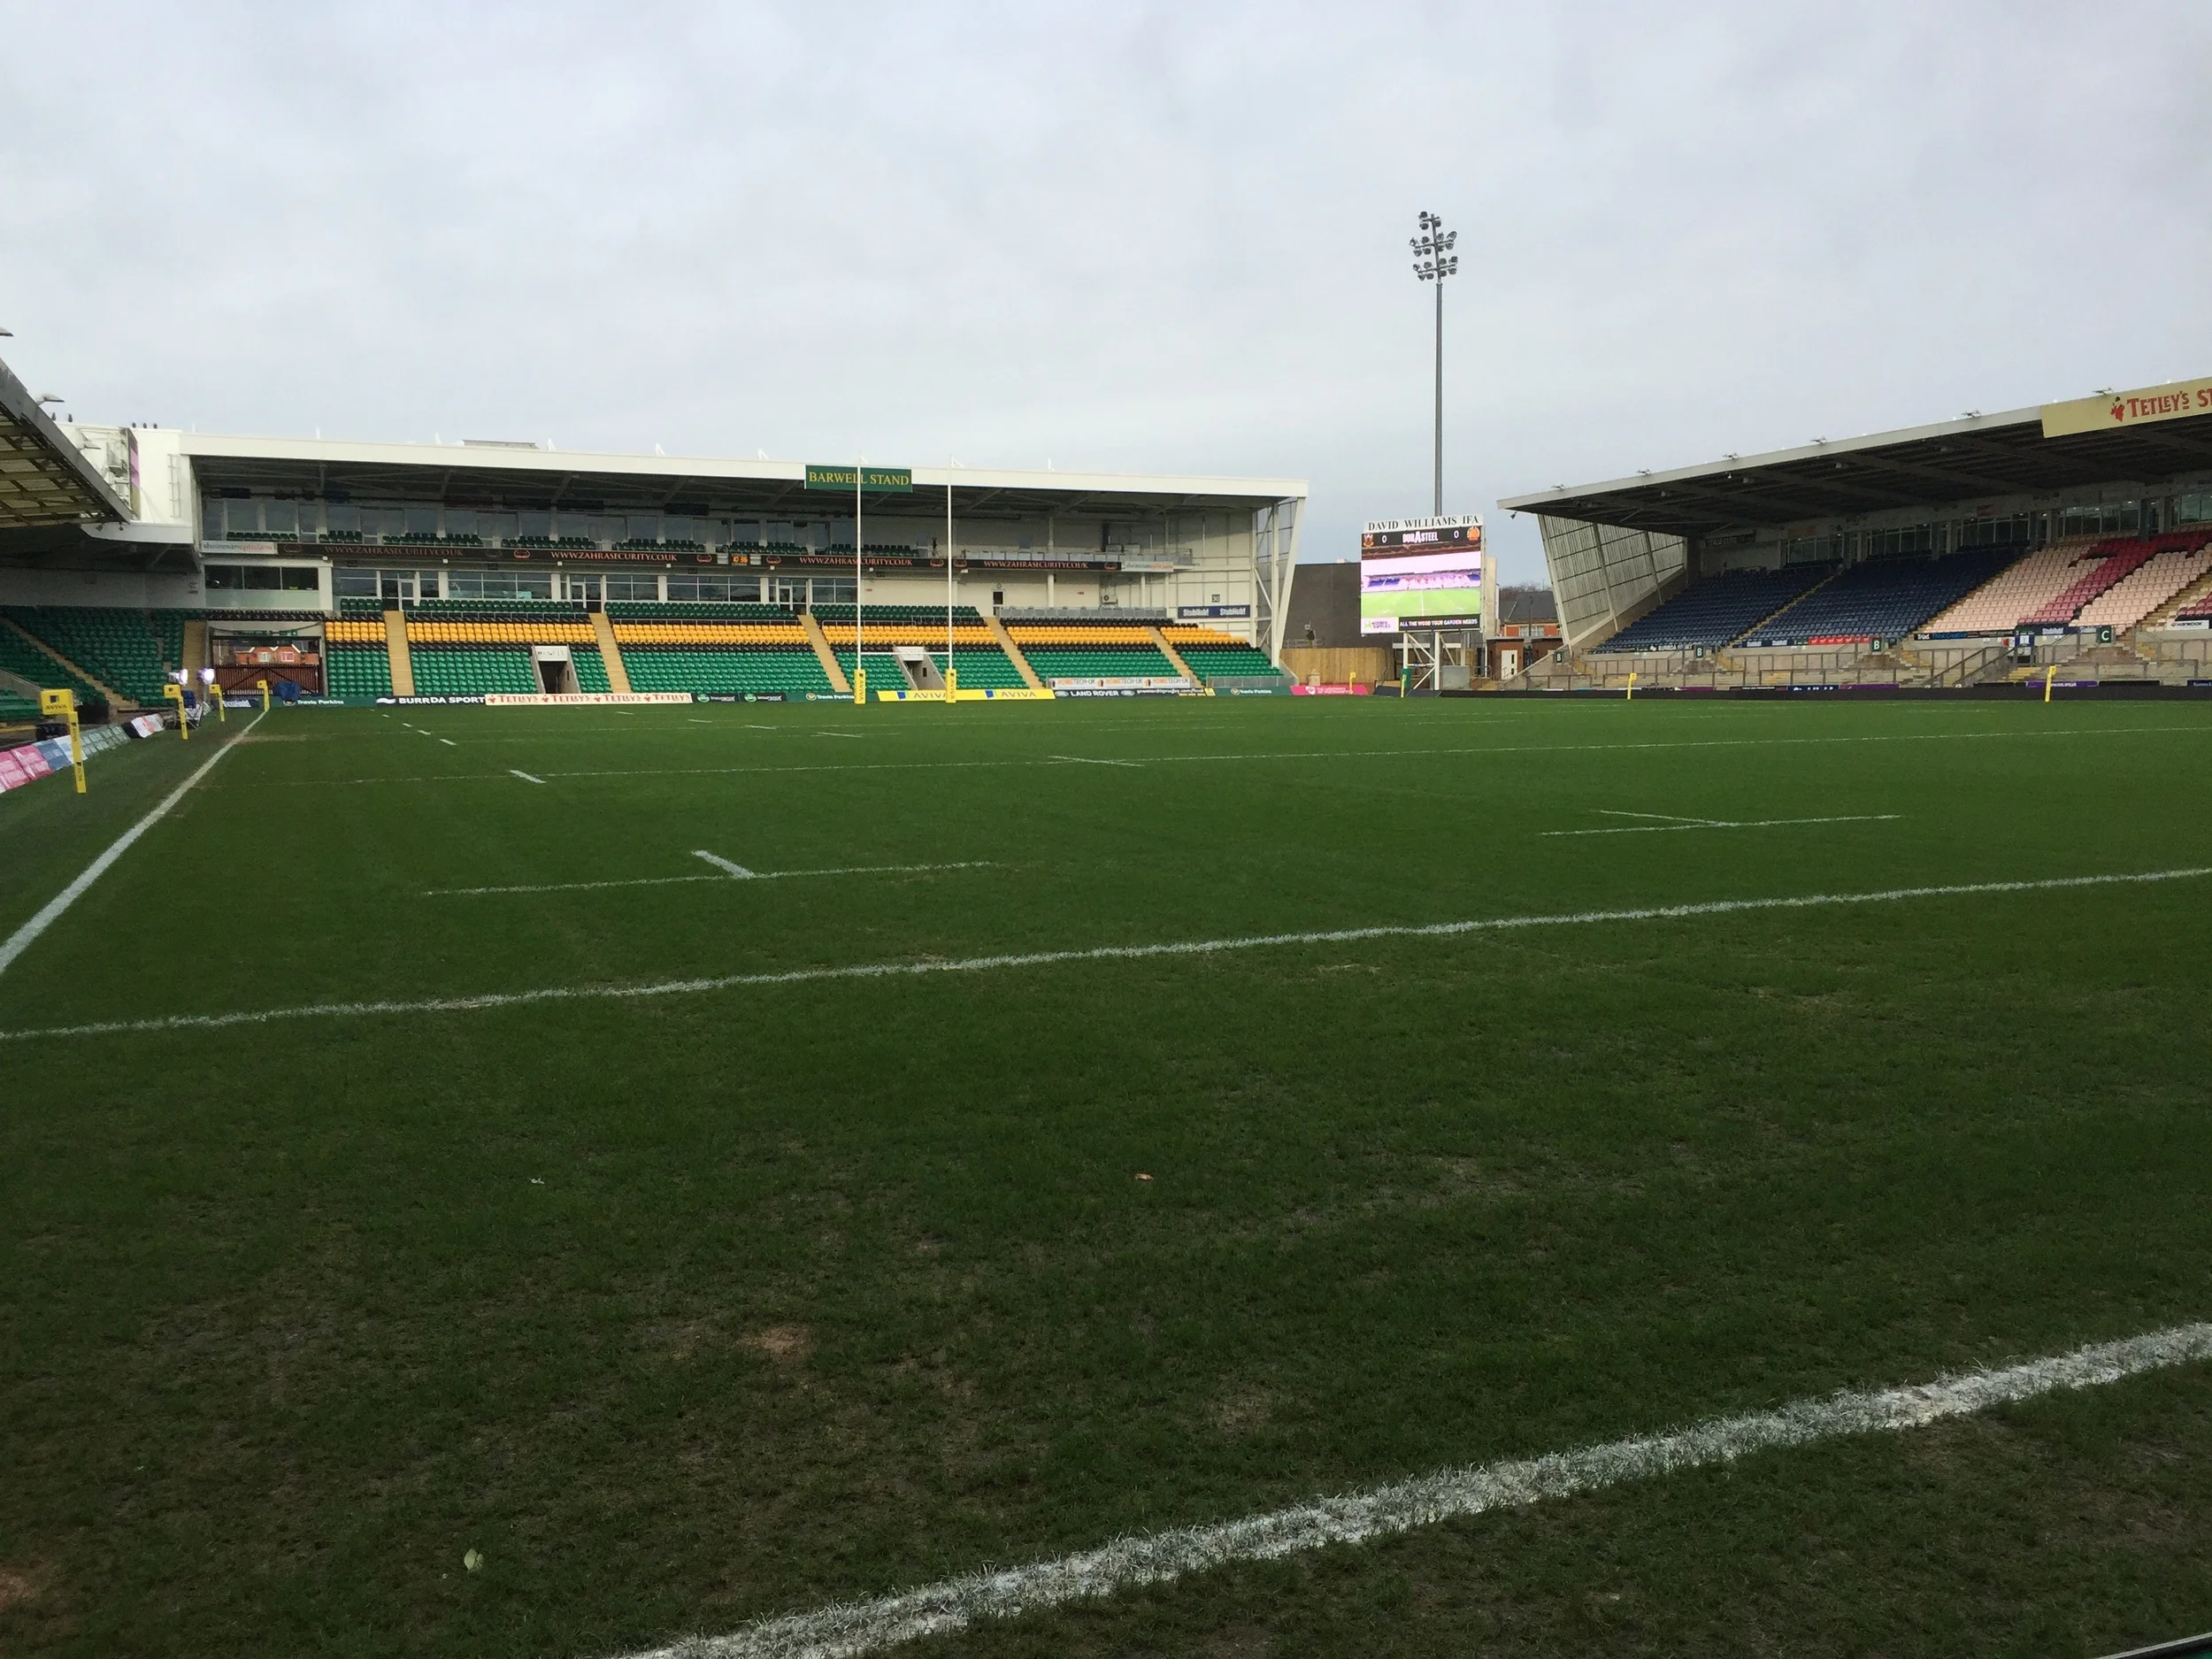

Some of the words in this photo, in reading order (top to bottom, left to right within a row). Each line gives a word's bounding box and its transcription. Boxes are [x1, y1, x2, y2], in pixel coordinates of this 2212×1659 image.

[2126, 390, 2190, 418] TETLEY'S
[809, 472, 867, 484] BARWELL
[870, 473, 910, 486] STAND
[1368, 520, 1399, 531] DAVID
[1404, 516, 1457, 528] WILLIAMS
[1463, 515, 1479, 525] IFA
[1381, 534, 1387, 543] 0
[1453, 530, 1459, 539] 0
[2101, 630, 2110, 641] C
[1873, 640, 1880, 650] B
[1697, 648, 1702, 657] B
